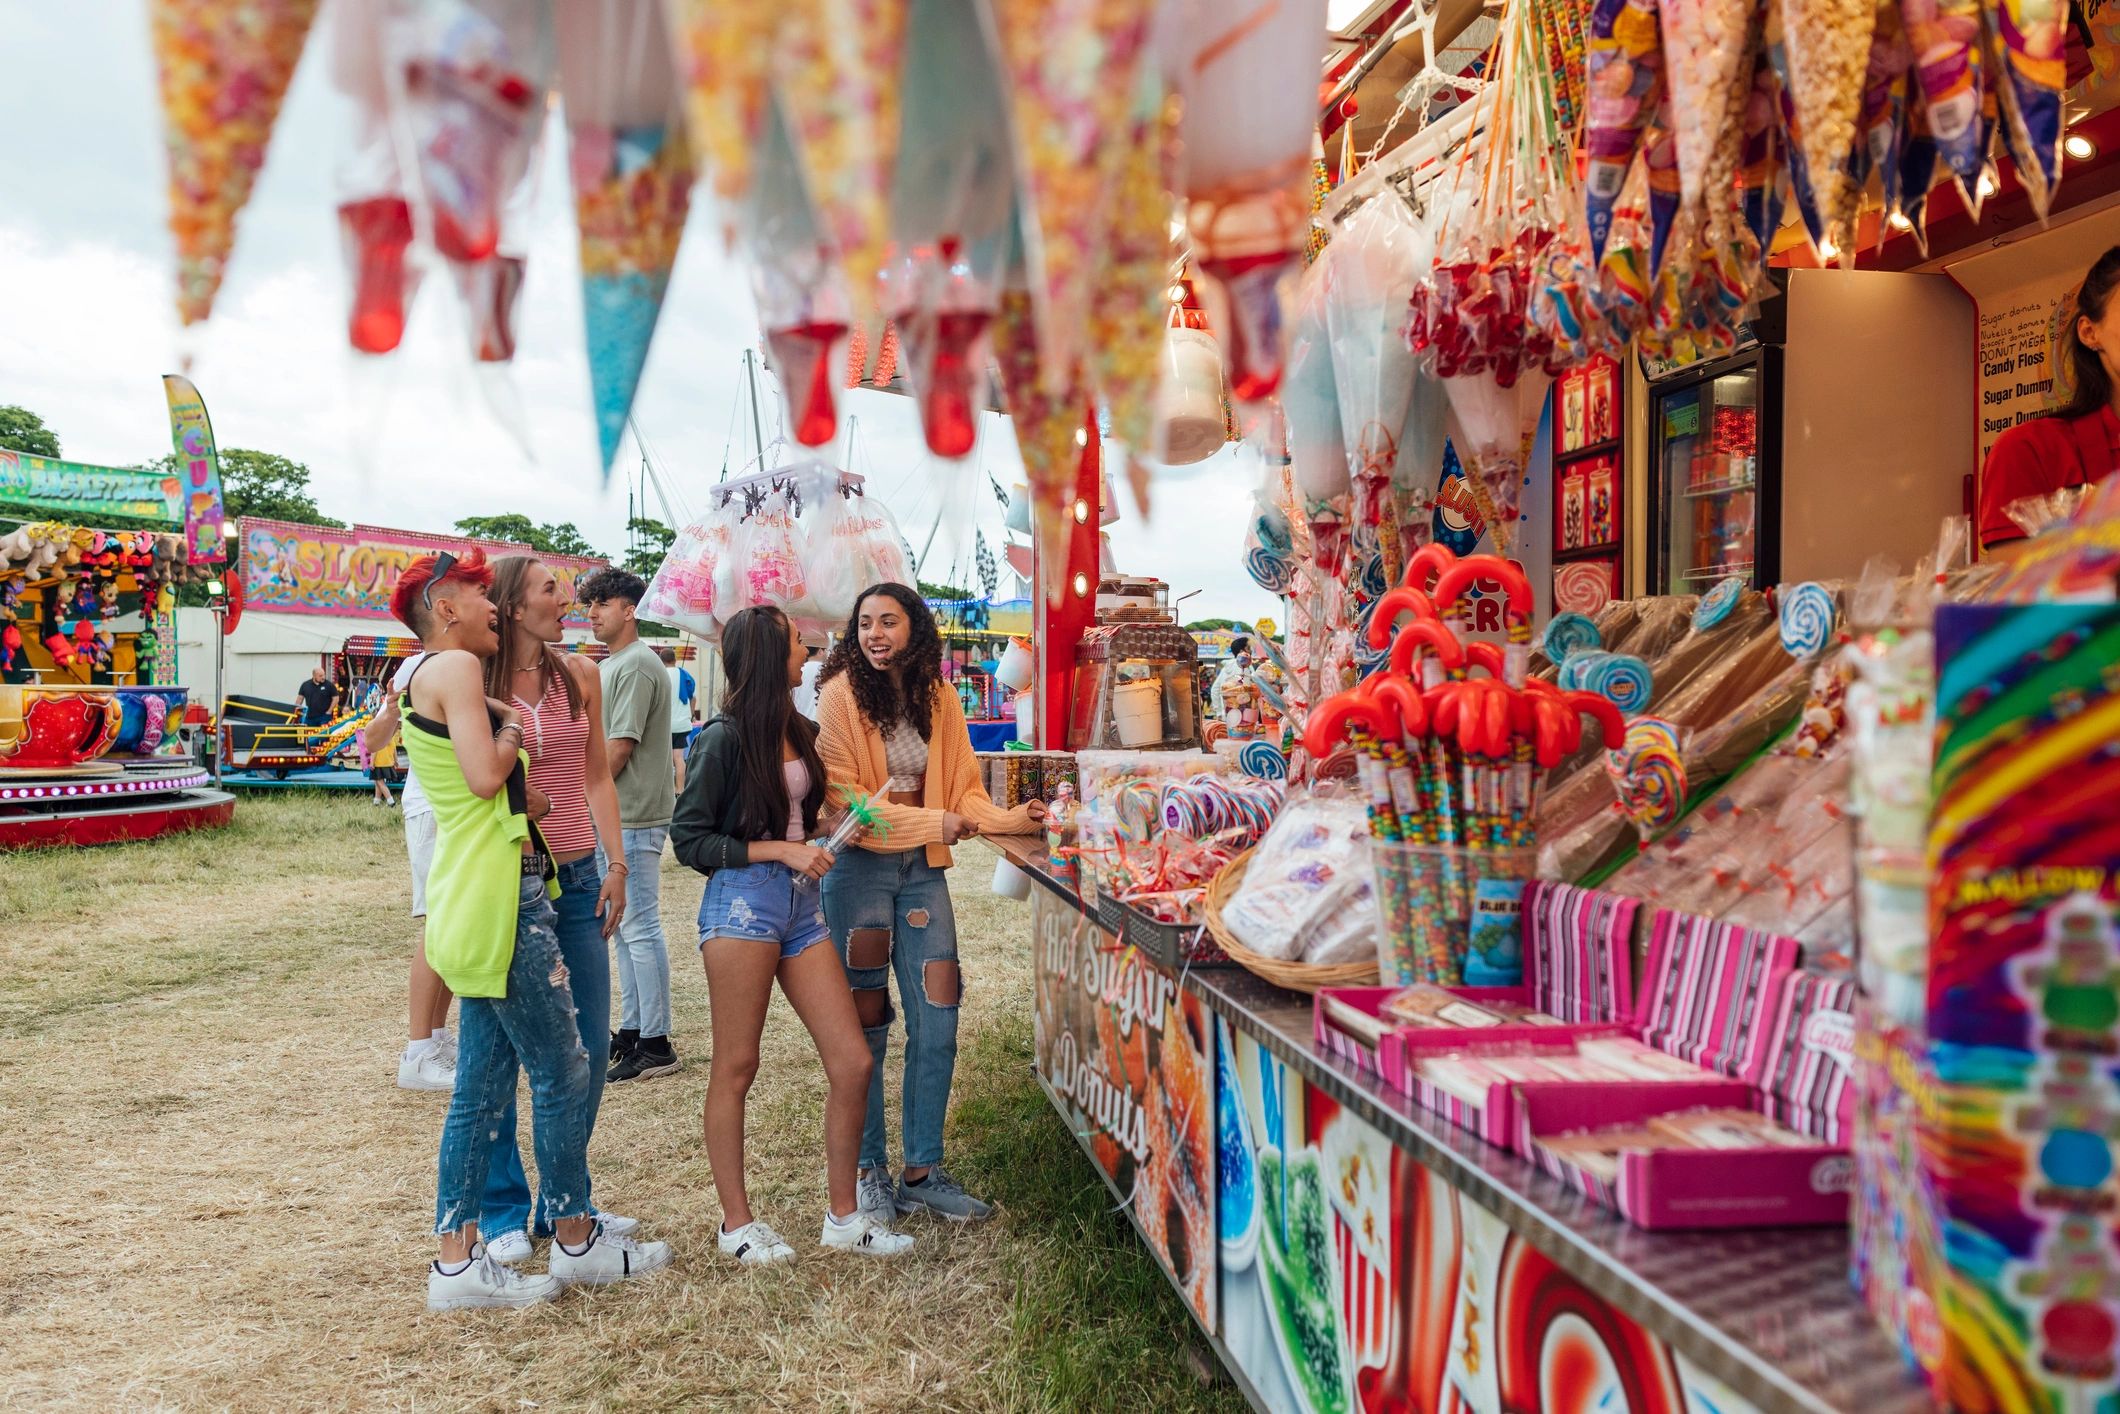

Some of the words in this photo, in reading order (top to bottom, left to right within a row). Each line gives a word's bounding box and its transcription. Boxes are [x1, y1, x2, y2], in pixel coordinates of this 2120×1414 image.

[1980, 327, 2013, 342] Nutella
[2017, 318, 2046, 331] donuts
[1981, 314, 2007, 328] Sugar
[1979, 343, 2016, 363] DONUT
[2019, 334, 2046, 351] MEGA
[1984, 358, 2015, 377] Candy
[2018, 351, 2045, 368] Floss
[1984, 388, 2013, 405] Sugar
[2016, 378, 2054, 397] Dummy
[1984, 416, 2013, 433] Sugar
[1044, 911, 1081, 985] Hot
[1084, 923, 1175, 1037] Sugar
[1060, 1030, 1152, 1162] Donuts
